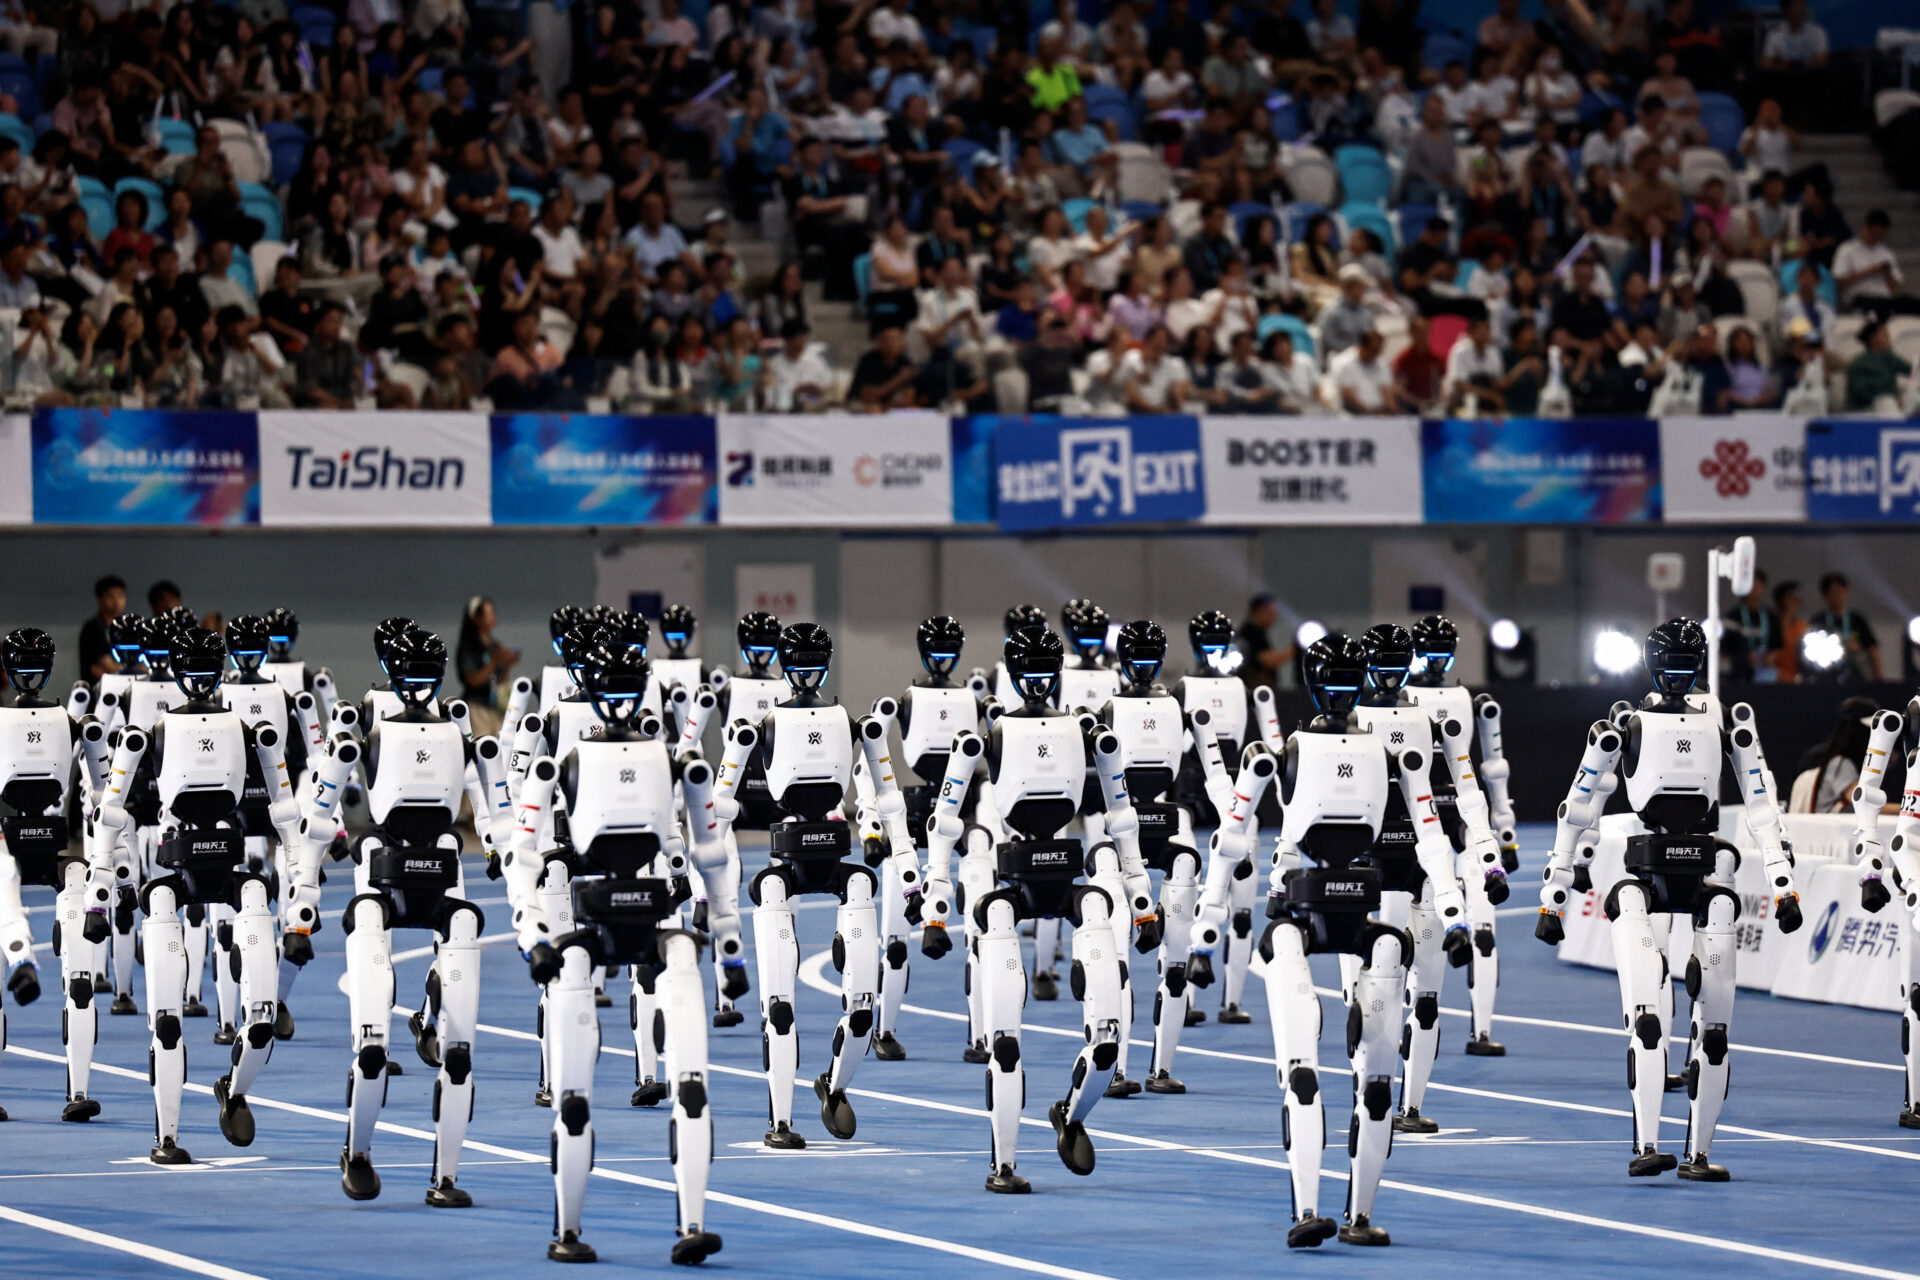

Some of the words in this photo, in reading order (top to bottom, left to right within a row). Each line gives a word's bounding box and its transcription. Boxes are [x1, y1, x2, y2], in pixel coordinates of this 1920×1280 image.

[1227, 437, 1376, 467] BOOSTER
[286, 446, 466, 490] TaiShan
[1134, 451, 1197, 494] EXIT
[511, 754, 519, 767] 8
[718, 764, 726, 778] 3
[1577, 769, 1587, 784] 7
[316, 784, 325, 799] 9
[942, 781, 953, 797] 8
